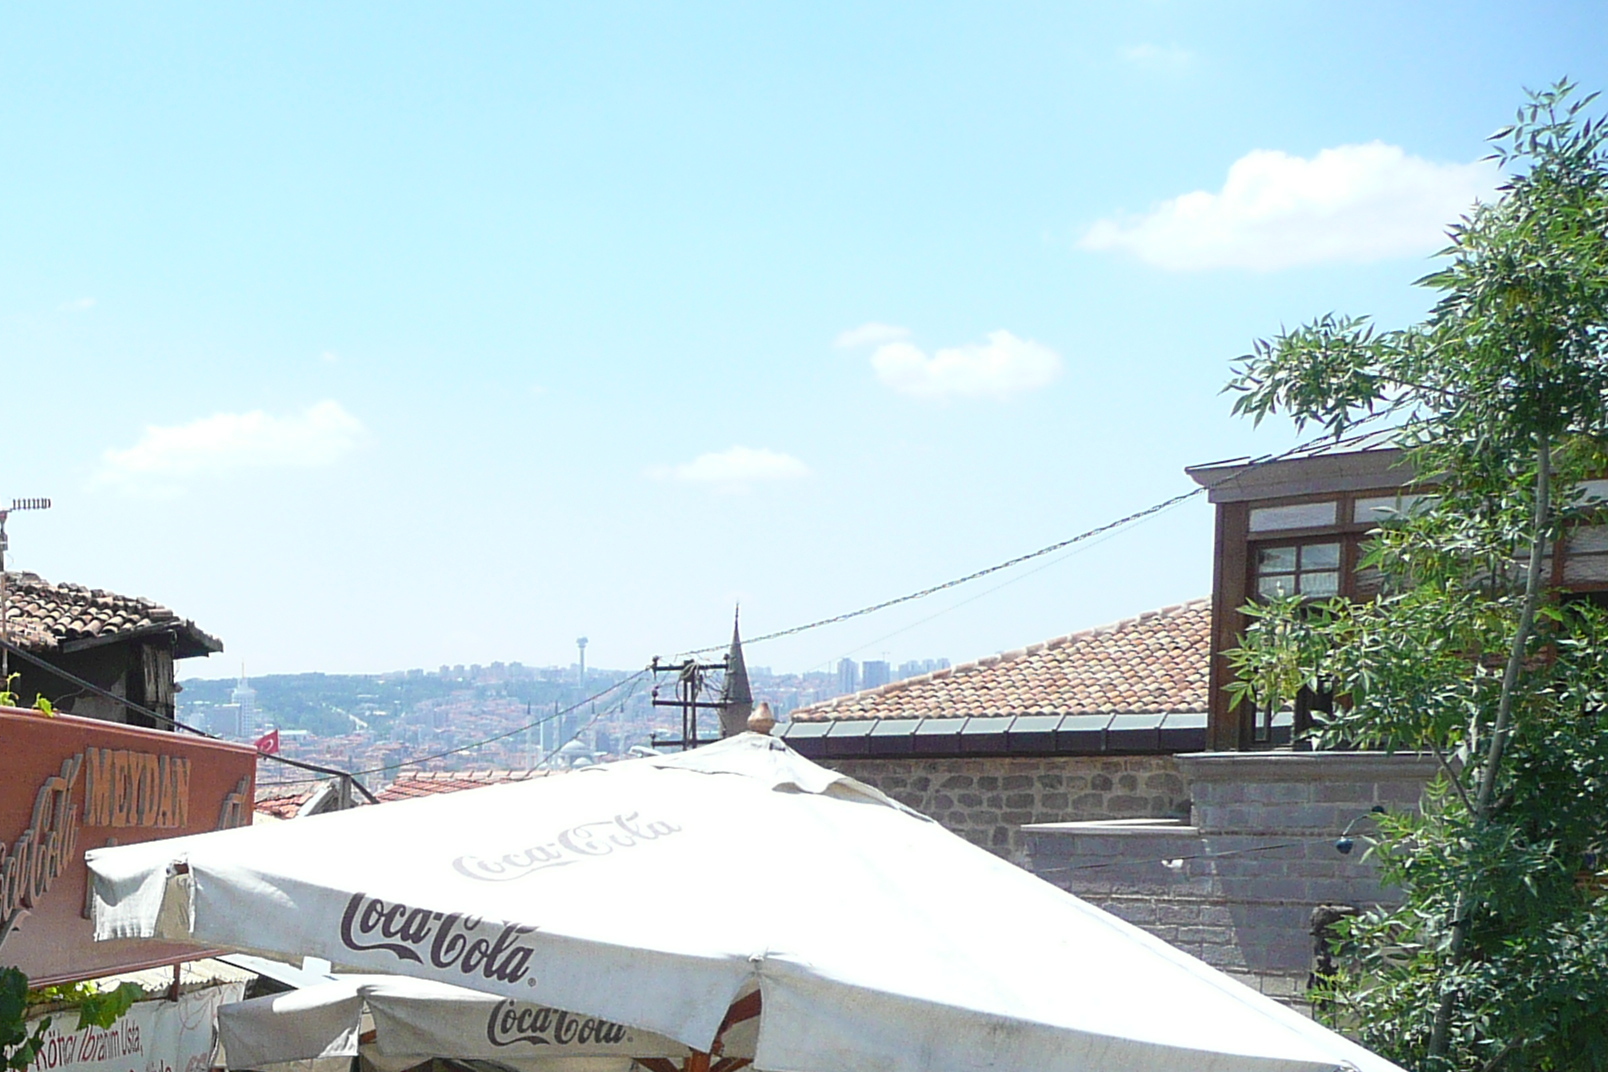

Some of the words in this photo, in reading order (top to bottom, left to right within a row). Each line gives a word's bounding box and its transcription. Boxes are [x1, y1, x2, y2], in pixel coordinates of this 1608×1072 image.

[82, 746, 192, 829] MEYDAN
[452, 811, 683, 882] Coca-Cola
[341, 892, 539, 984] Coca-Cola
